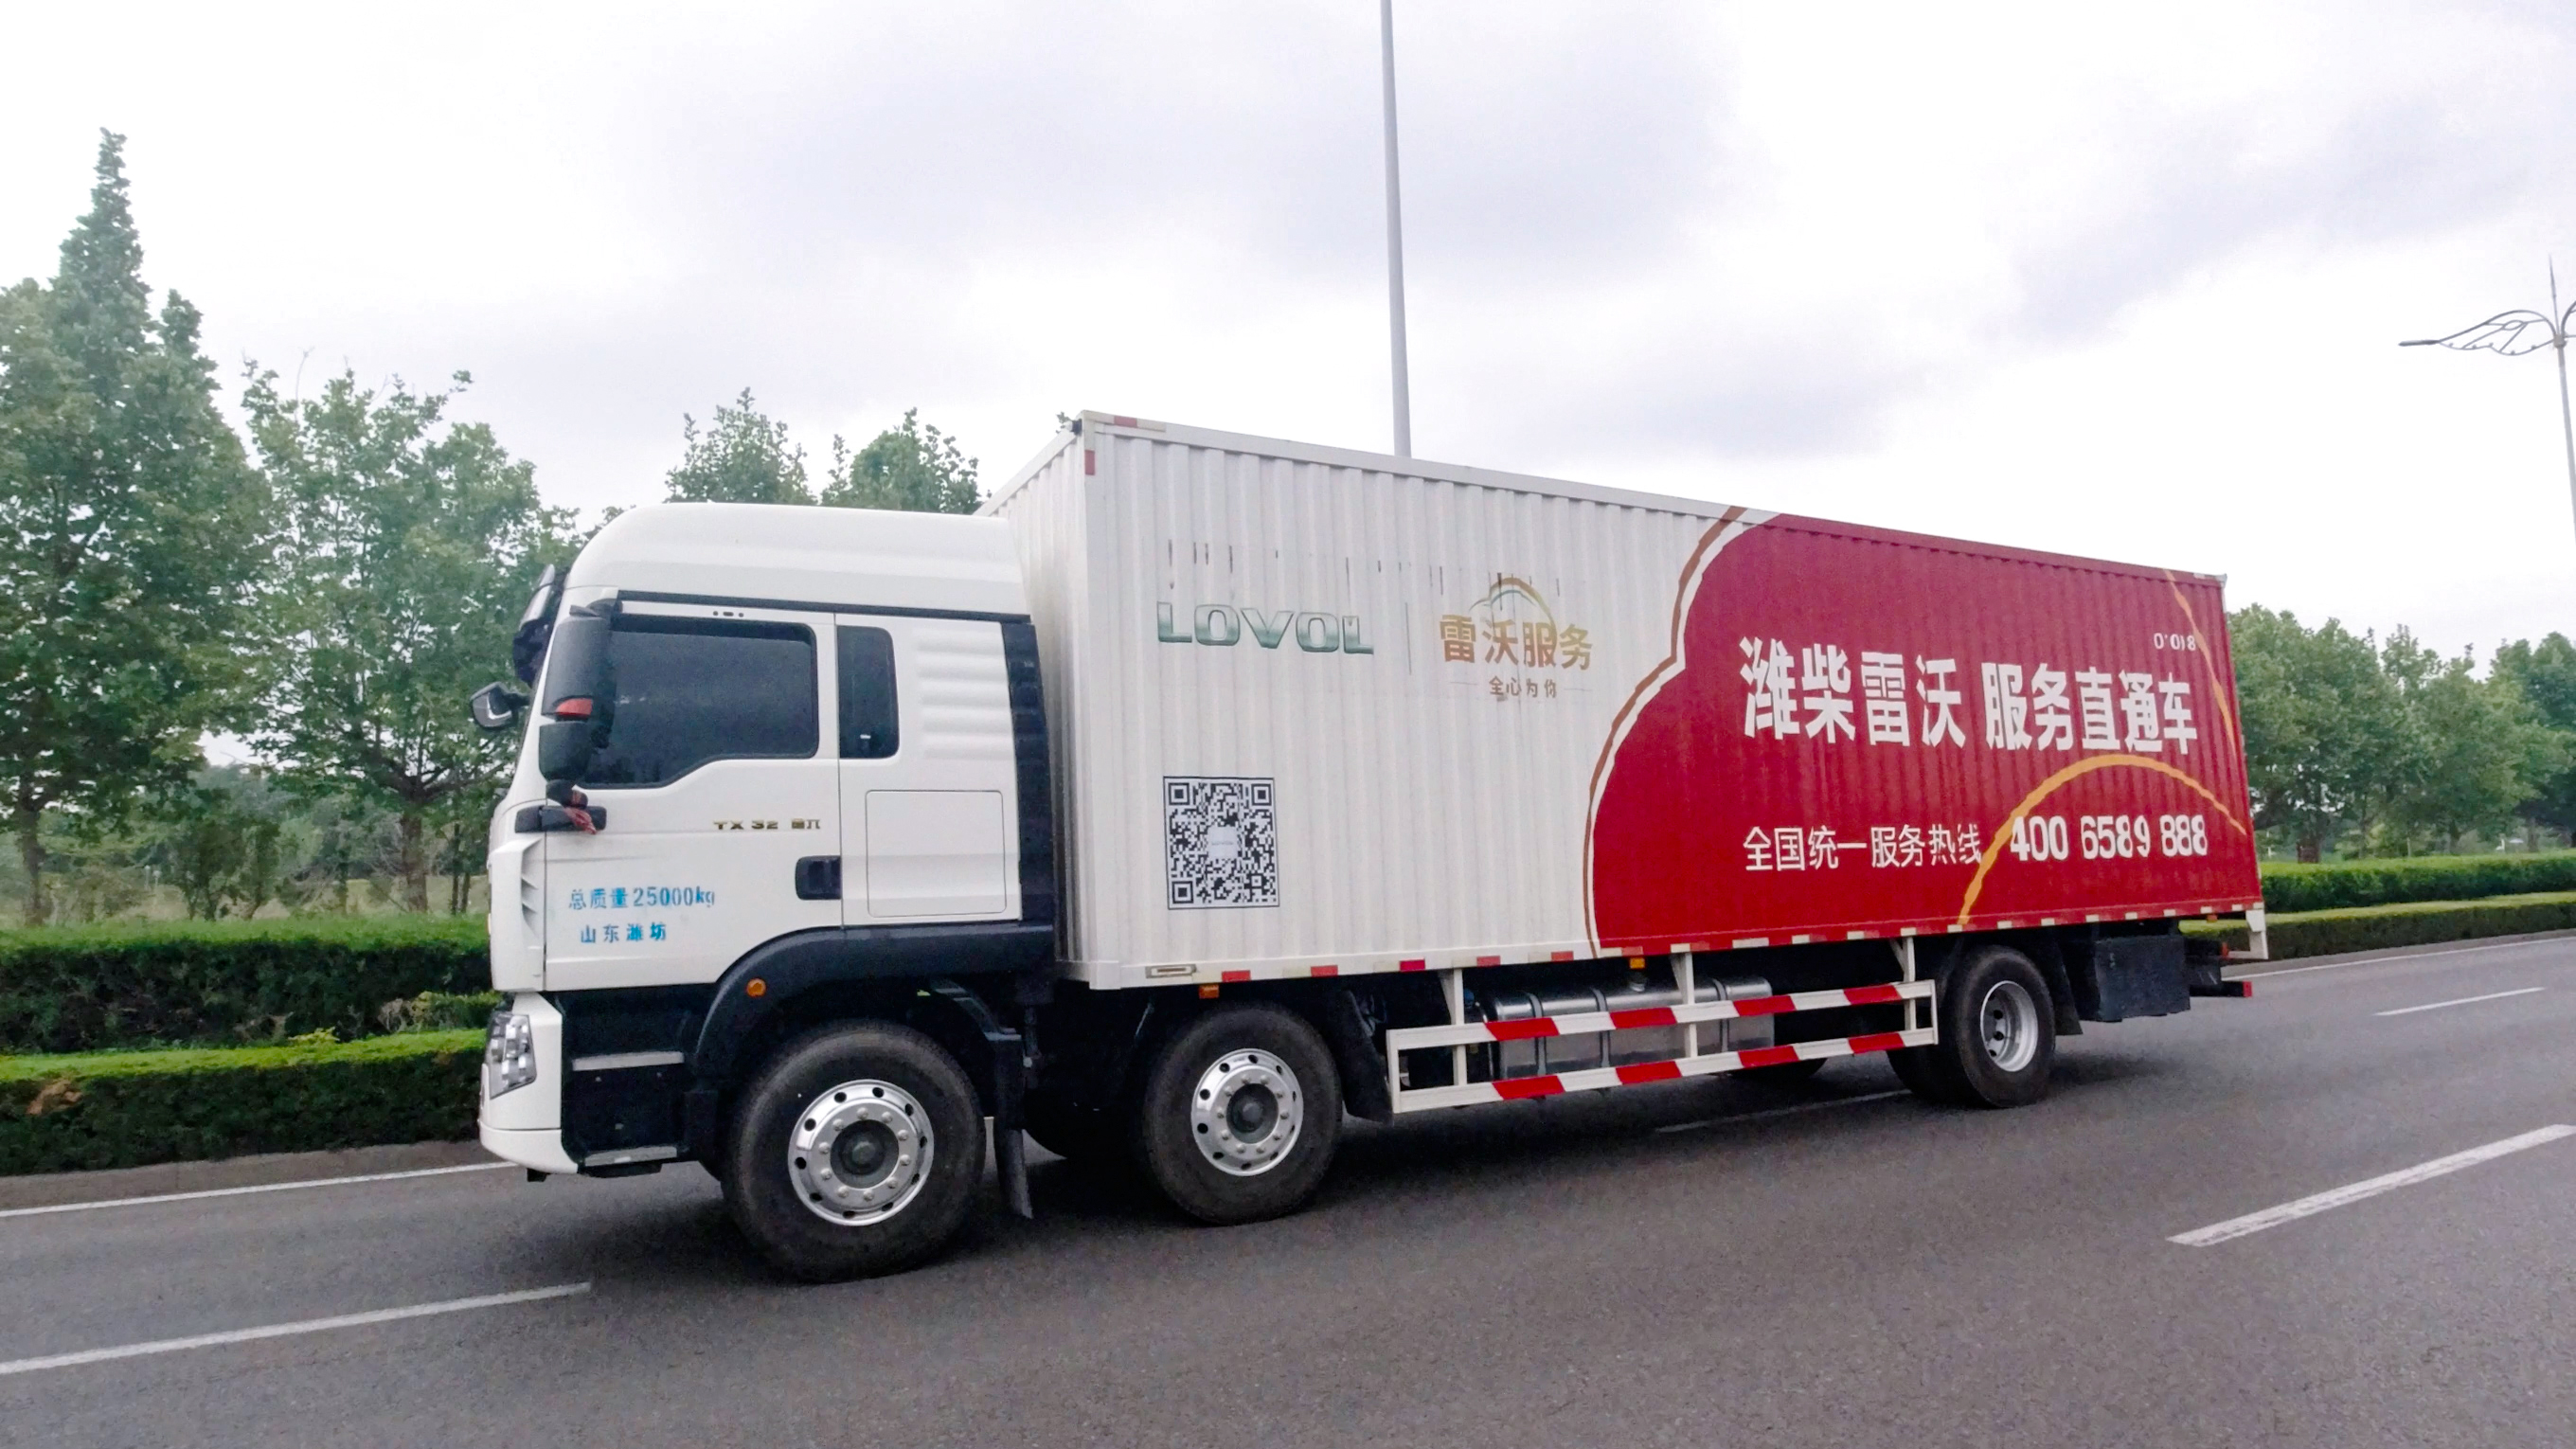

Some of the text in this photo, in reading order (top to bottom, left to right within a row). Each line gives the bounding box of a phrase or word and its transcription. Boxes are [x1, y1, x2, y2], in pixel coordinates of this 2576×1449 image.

[1157, 601, 1373, 654] LOVOL
[1440, 615, 1593, 670] 雷沃服务
[1489, 675, 1557, 698] 全心为你
[1739, 636, 2197, 755] 潍柴雷沃 服务直通车
[713, 820, 744, 830] TX
[1743, 814, 2208, 872] 全国统一服务热线 400 6589 888
